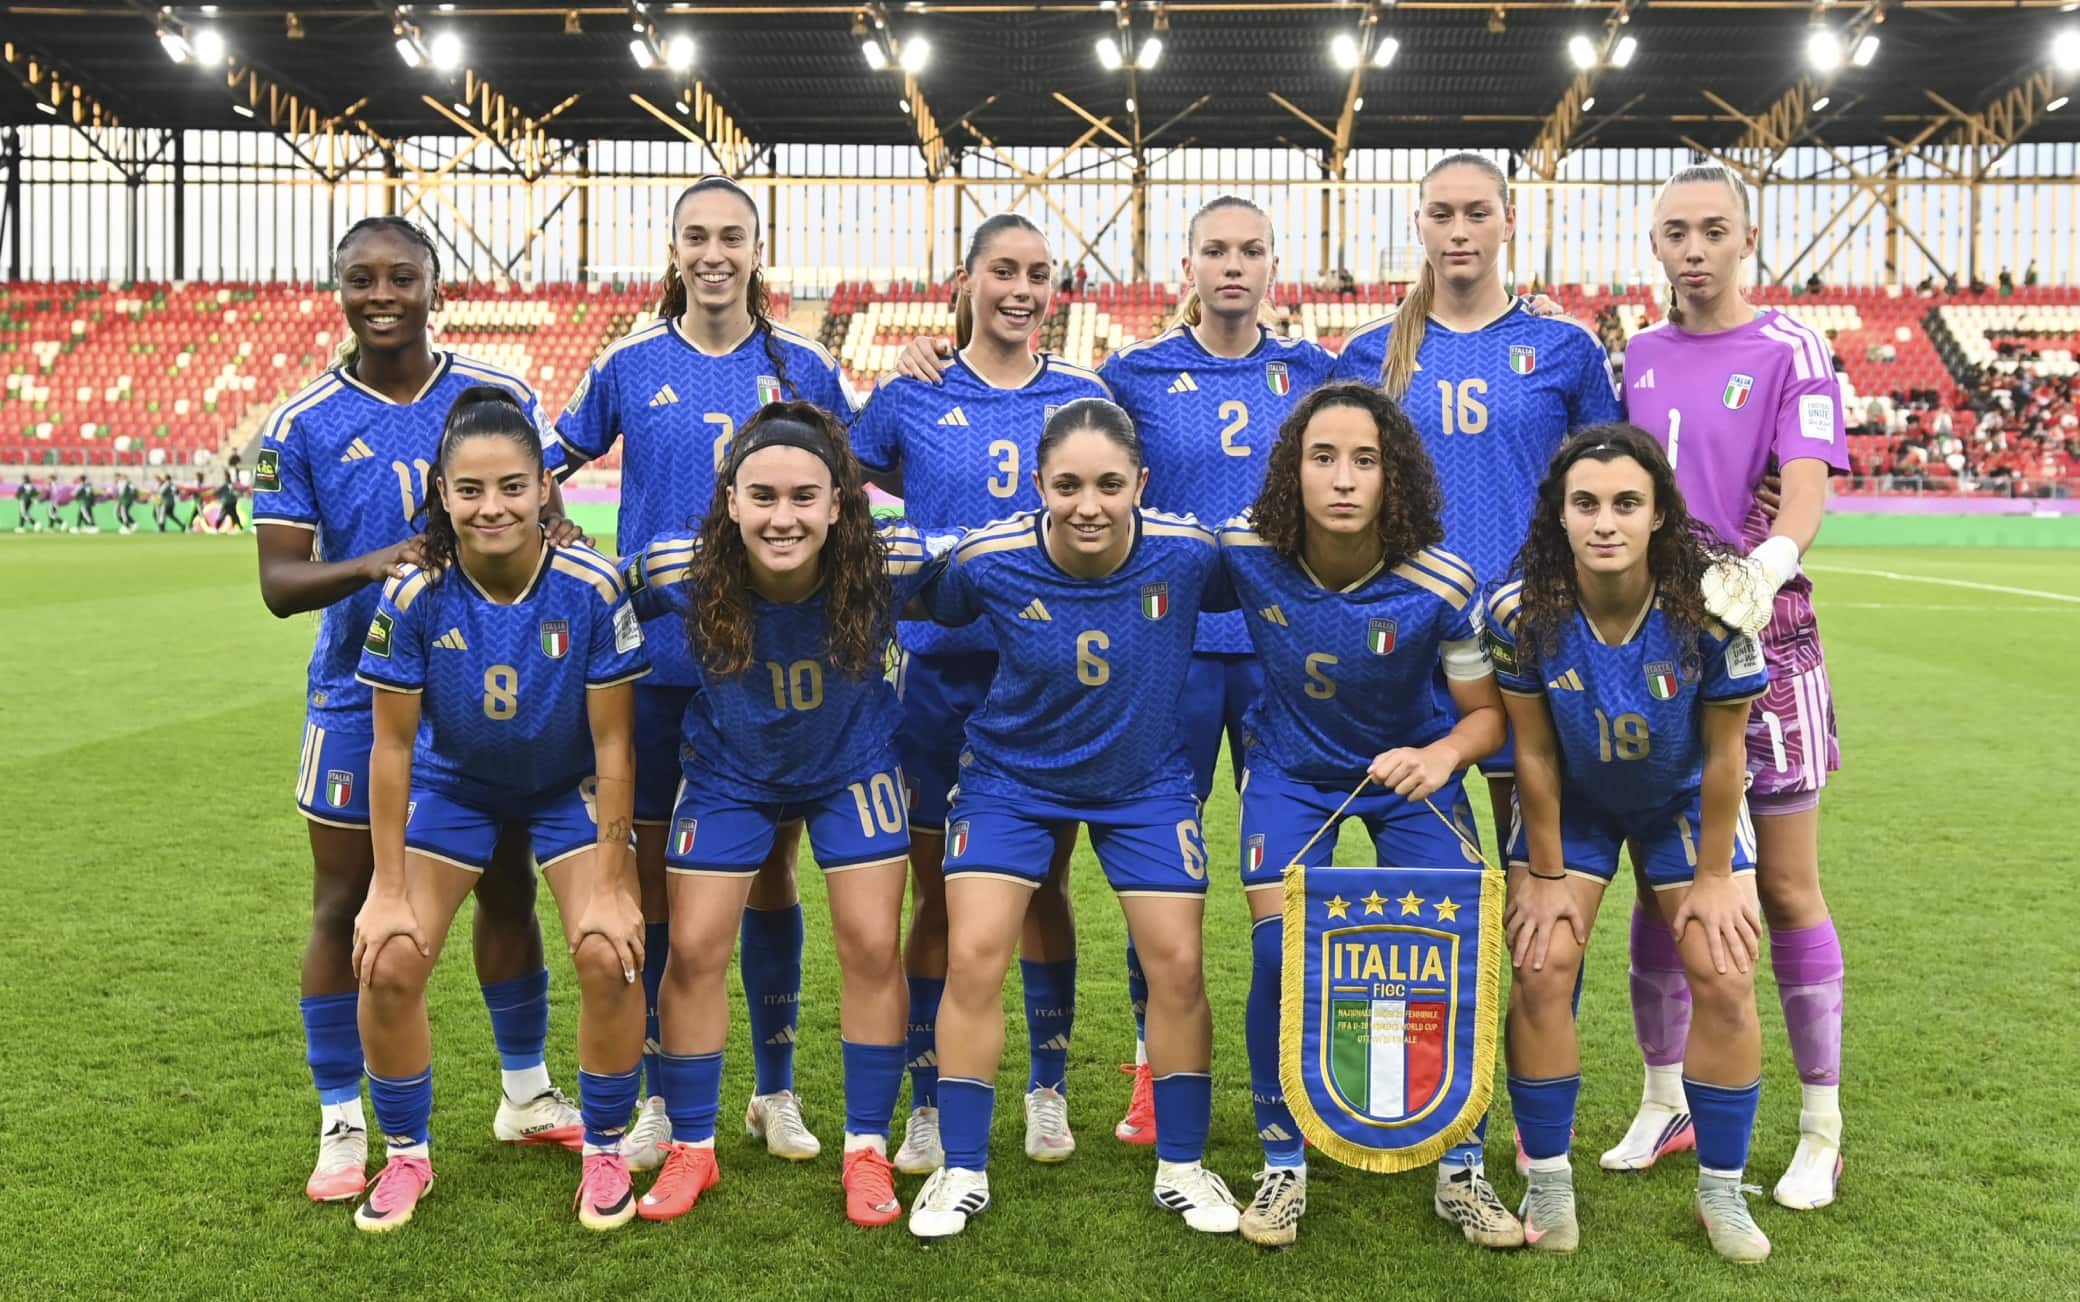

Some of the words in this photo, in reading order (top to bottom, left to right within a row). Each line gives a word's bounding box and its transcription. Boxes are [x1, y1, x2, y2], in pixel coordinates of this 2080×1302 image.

[1218, 400, 1251, 457] 2
[1437, 378, 1489, 436] 16
[703, 412, 734, 473] 7
[1668, 408, 1681, 470] 1
[391, 458, 431, 522] 11
[987, 439, 1020, 498] 3
[767, 659, 824, 711] 10
[1076, 630, 1110, 686] 6
[1304, 652, 1339, 700] 5
[483, 664, 518, 721] 8
[1594, 708, 1651, 763] 18
[1762, 711, 1788, 773] 1
[848, 772, 902, 838] 10
[1176, 819, 1205, 880] 6
[1335, 943, 1446, 982] ITALIA
[1373, 983, 1406, 998] FIGC
[1425, 1023, 1438, 1032] CUP
[520, 1122, 555, 1135] ULTRA
